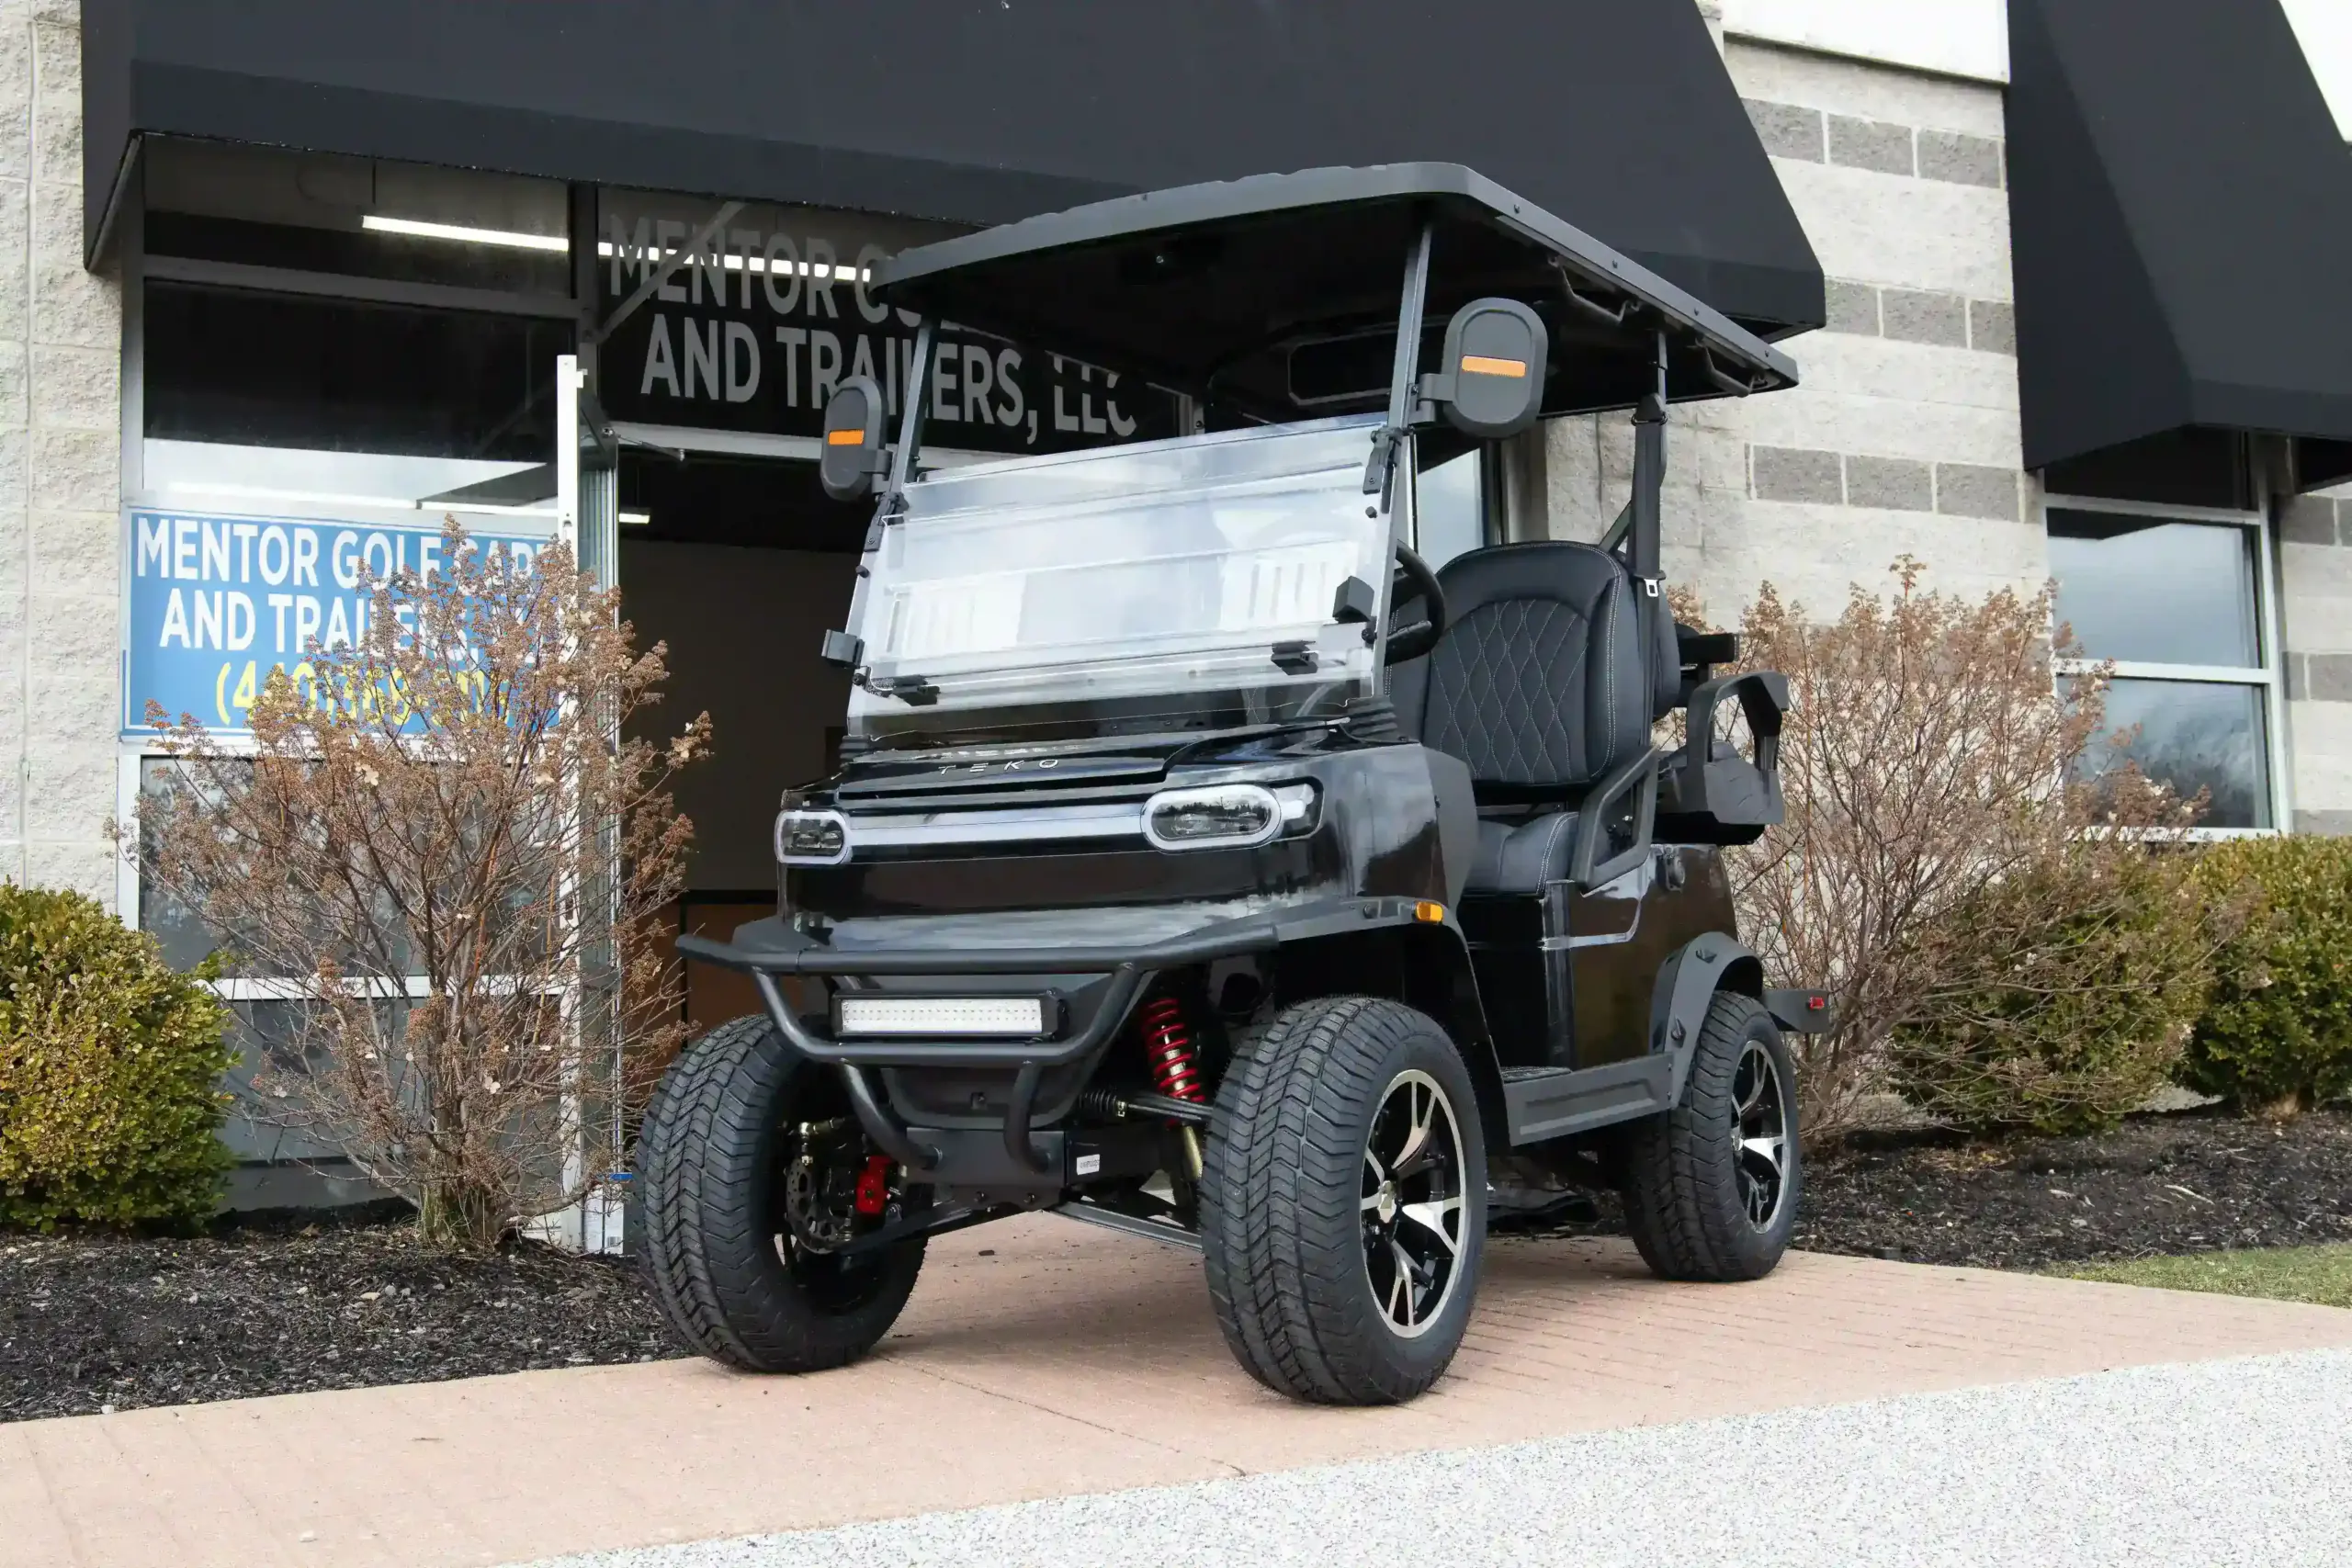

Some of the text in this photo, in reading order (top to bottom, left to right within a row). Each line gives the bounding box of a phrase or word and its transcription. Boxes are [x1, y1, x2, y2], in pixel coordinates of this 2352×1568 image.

[610, 213, 839, 319] MENTOR
[640, 313, 761, 403] AND
[137, 517, 319, 586] MENTOR
[333, 530, 442, 591] GOLF
[159, 588, 255, 650] AND
[938, 759, 1058, 775] TEKO
